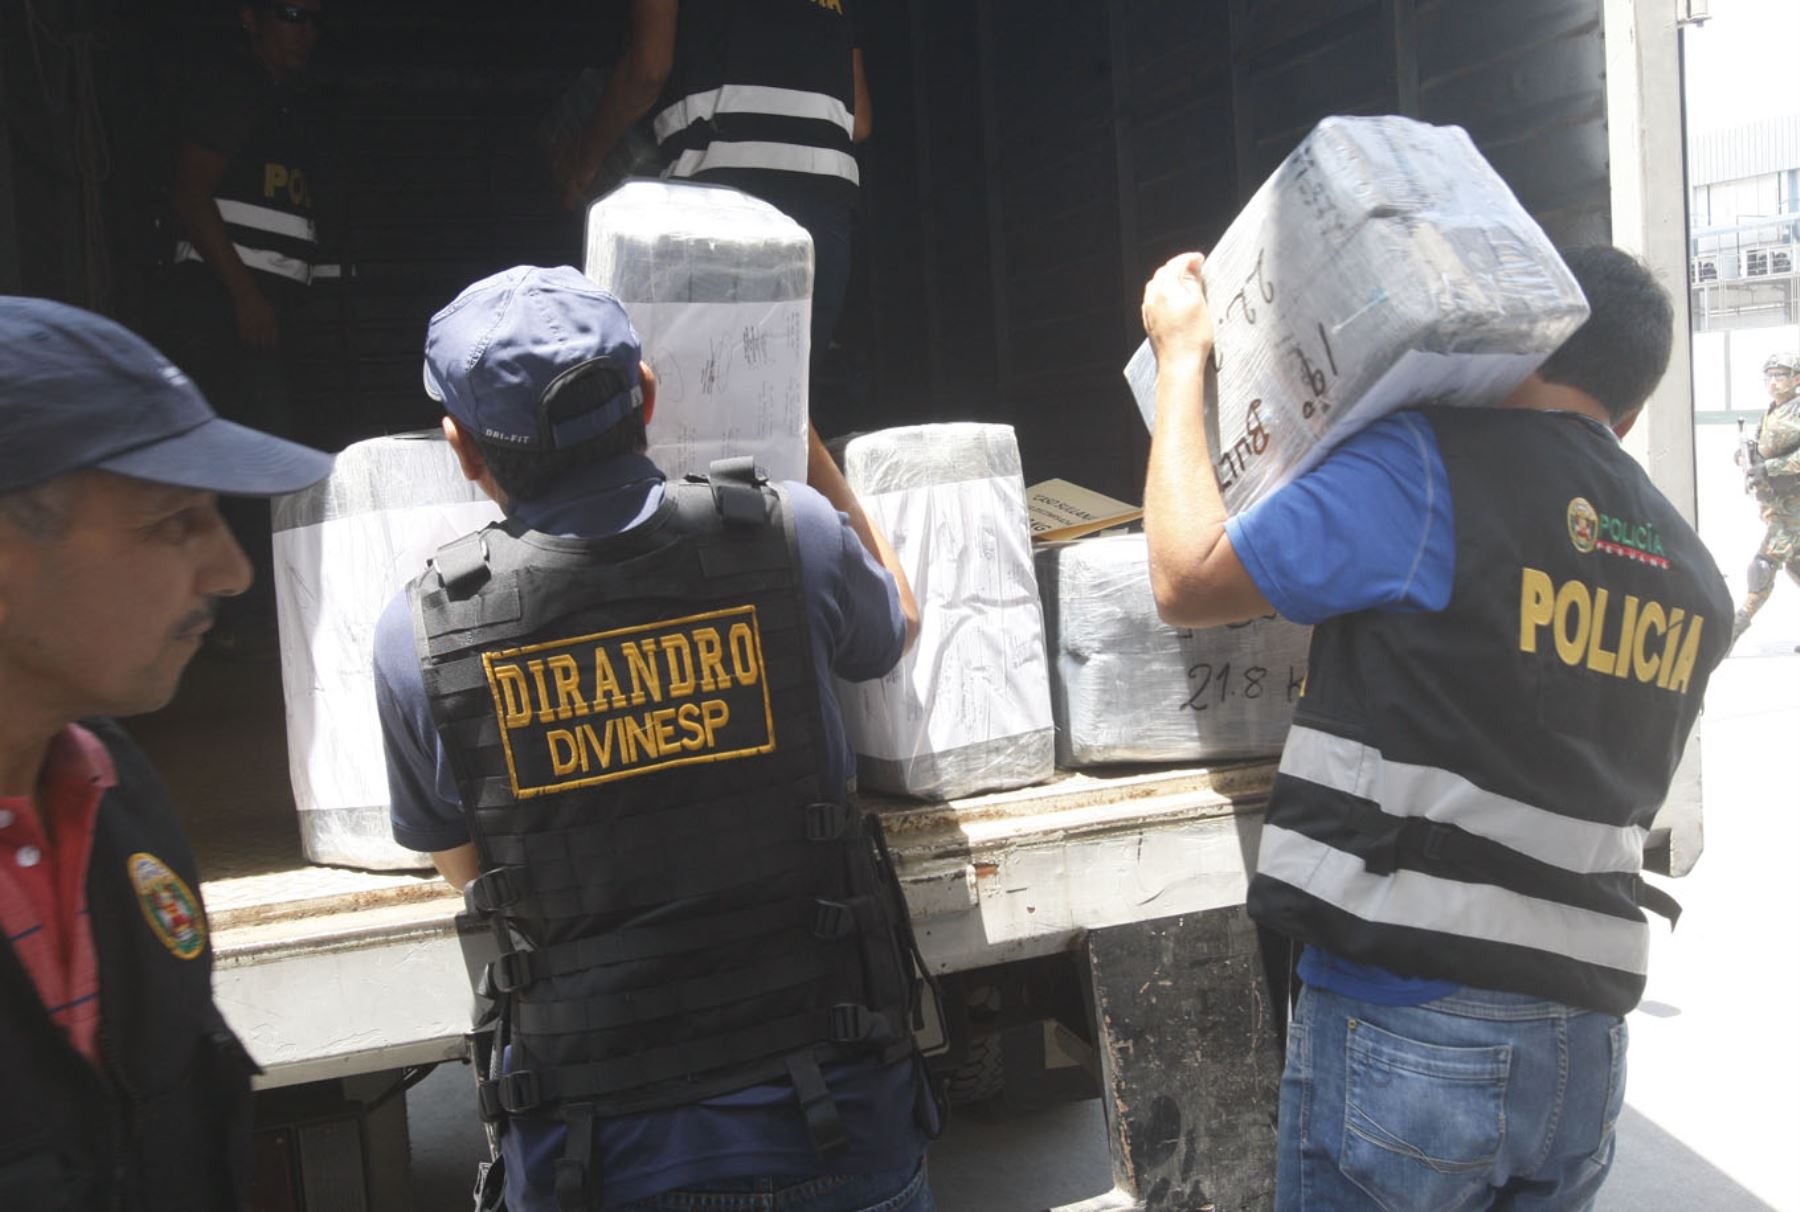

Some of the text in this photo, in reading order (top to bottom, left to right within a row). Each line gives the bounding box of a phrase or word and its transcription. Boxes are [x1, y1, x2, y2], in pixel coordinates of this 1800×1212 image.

[485, 428, 530, 445] DRI-FIT
[1215, 397, 1271, 494] BULT
[494, 622, 758, 729] DIRANDRO
[1179, 661, 1268, 712] 21.8
[546, 698, 730, 778] DIVINESP
